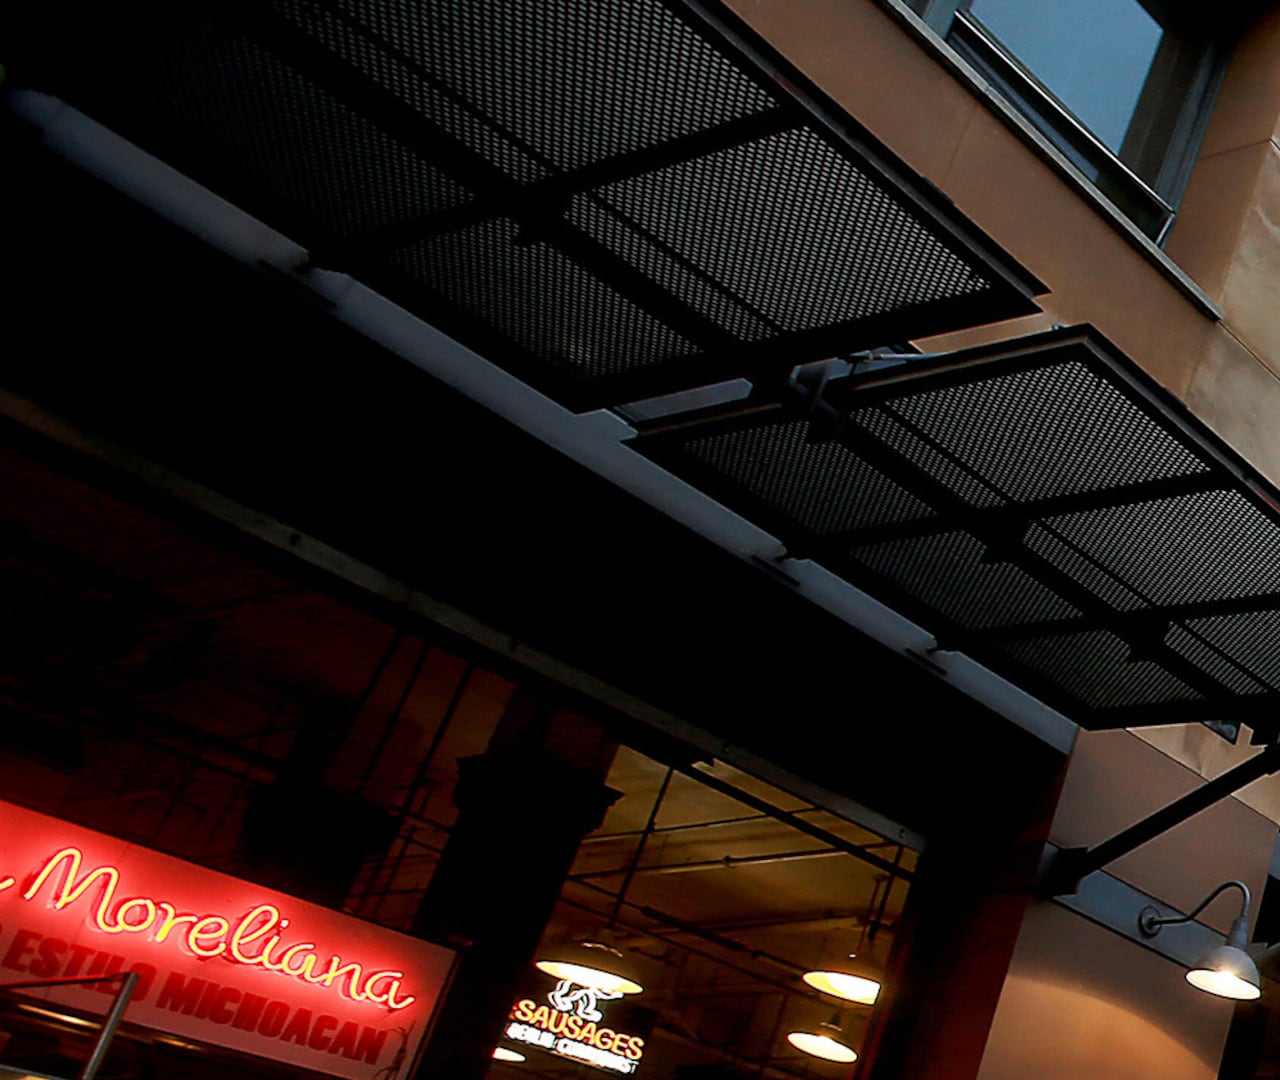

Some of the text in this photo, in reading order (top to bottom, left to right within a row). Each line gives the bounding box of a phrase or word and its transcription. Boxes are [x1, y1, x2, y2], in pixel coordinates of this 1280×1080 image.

[2, 928, 387, 1067] ESTILO MICHOACAN
[23, 846, 415, 1010] Moreliana
[513, 999, 645, 1061] SAUSAGES
